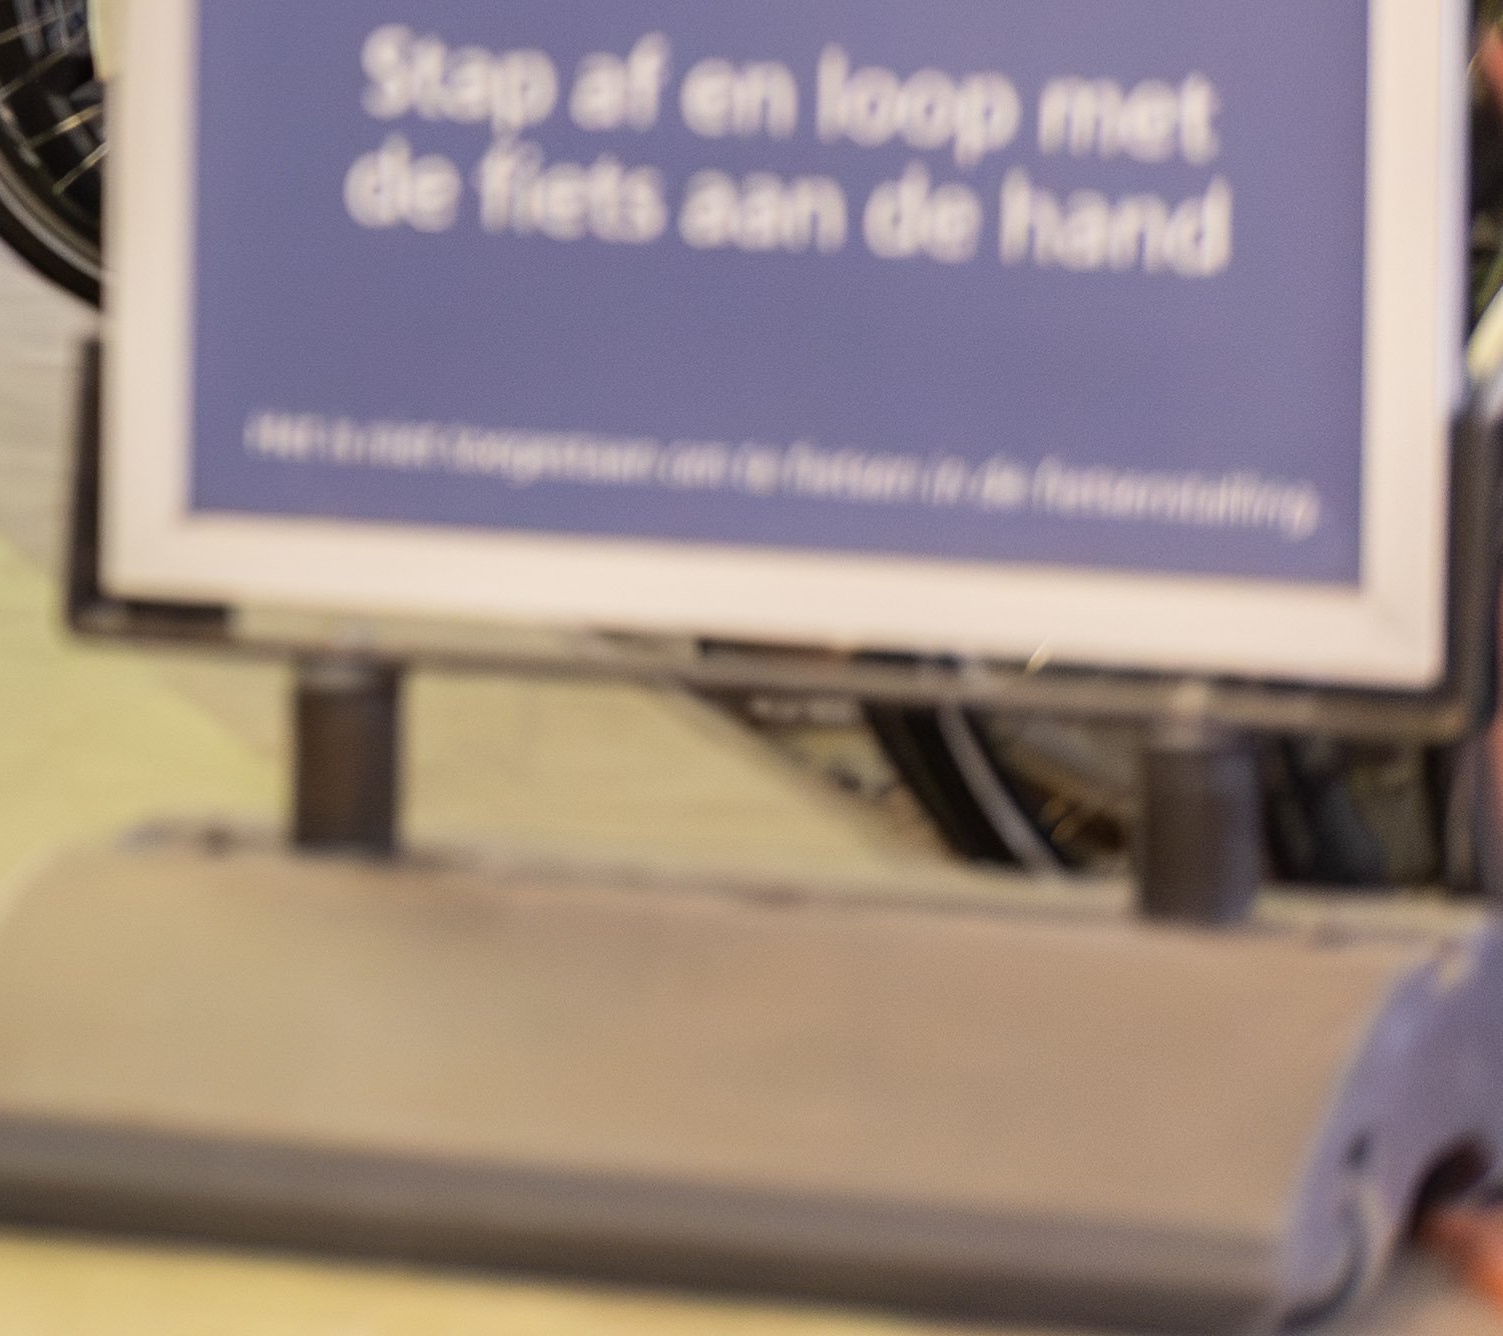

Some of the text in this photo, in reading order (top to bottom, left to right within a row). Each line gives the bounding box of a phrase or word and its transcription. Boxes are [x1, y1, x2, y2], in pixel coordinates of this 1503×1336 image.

[361, 23, 1221, 168] Stap af en loop met
[343, 132, 1233, 278] de fiets aan de hand
